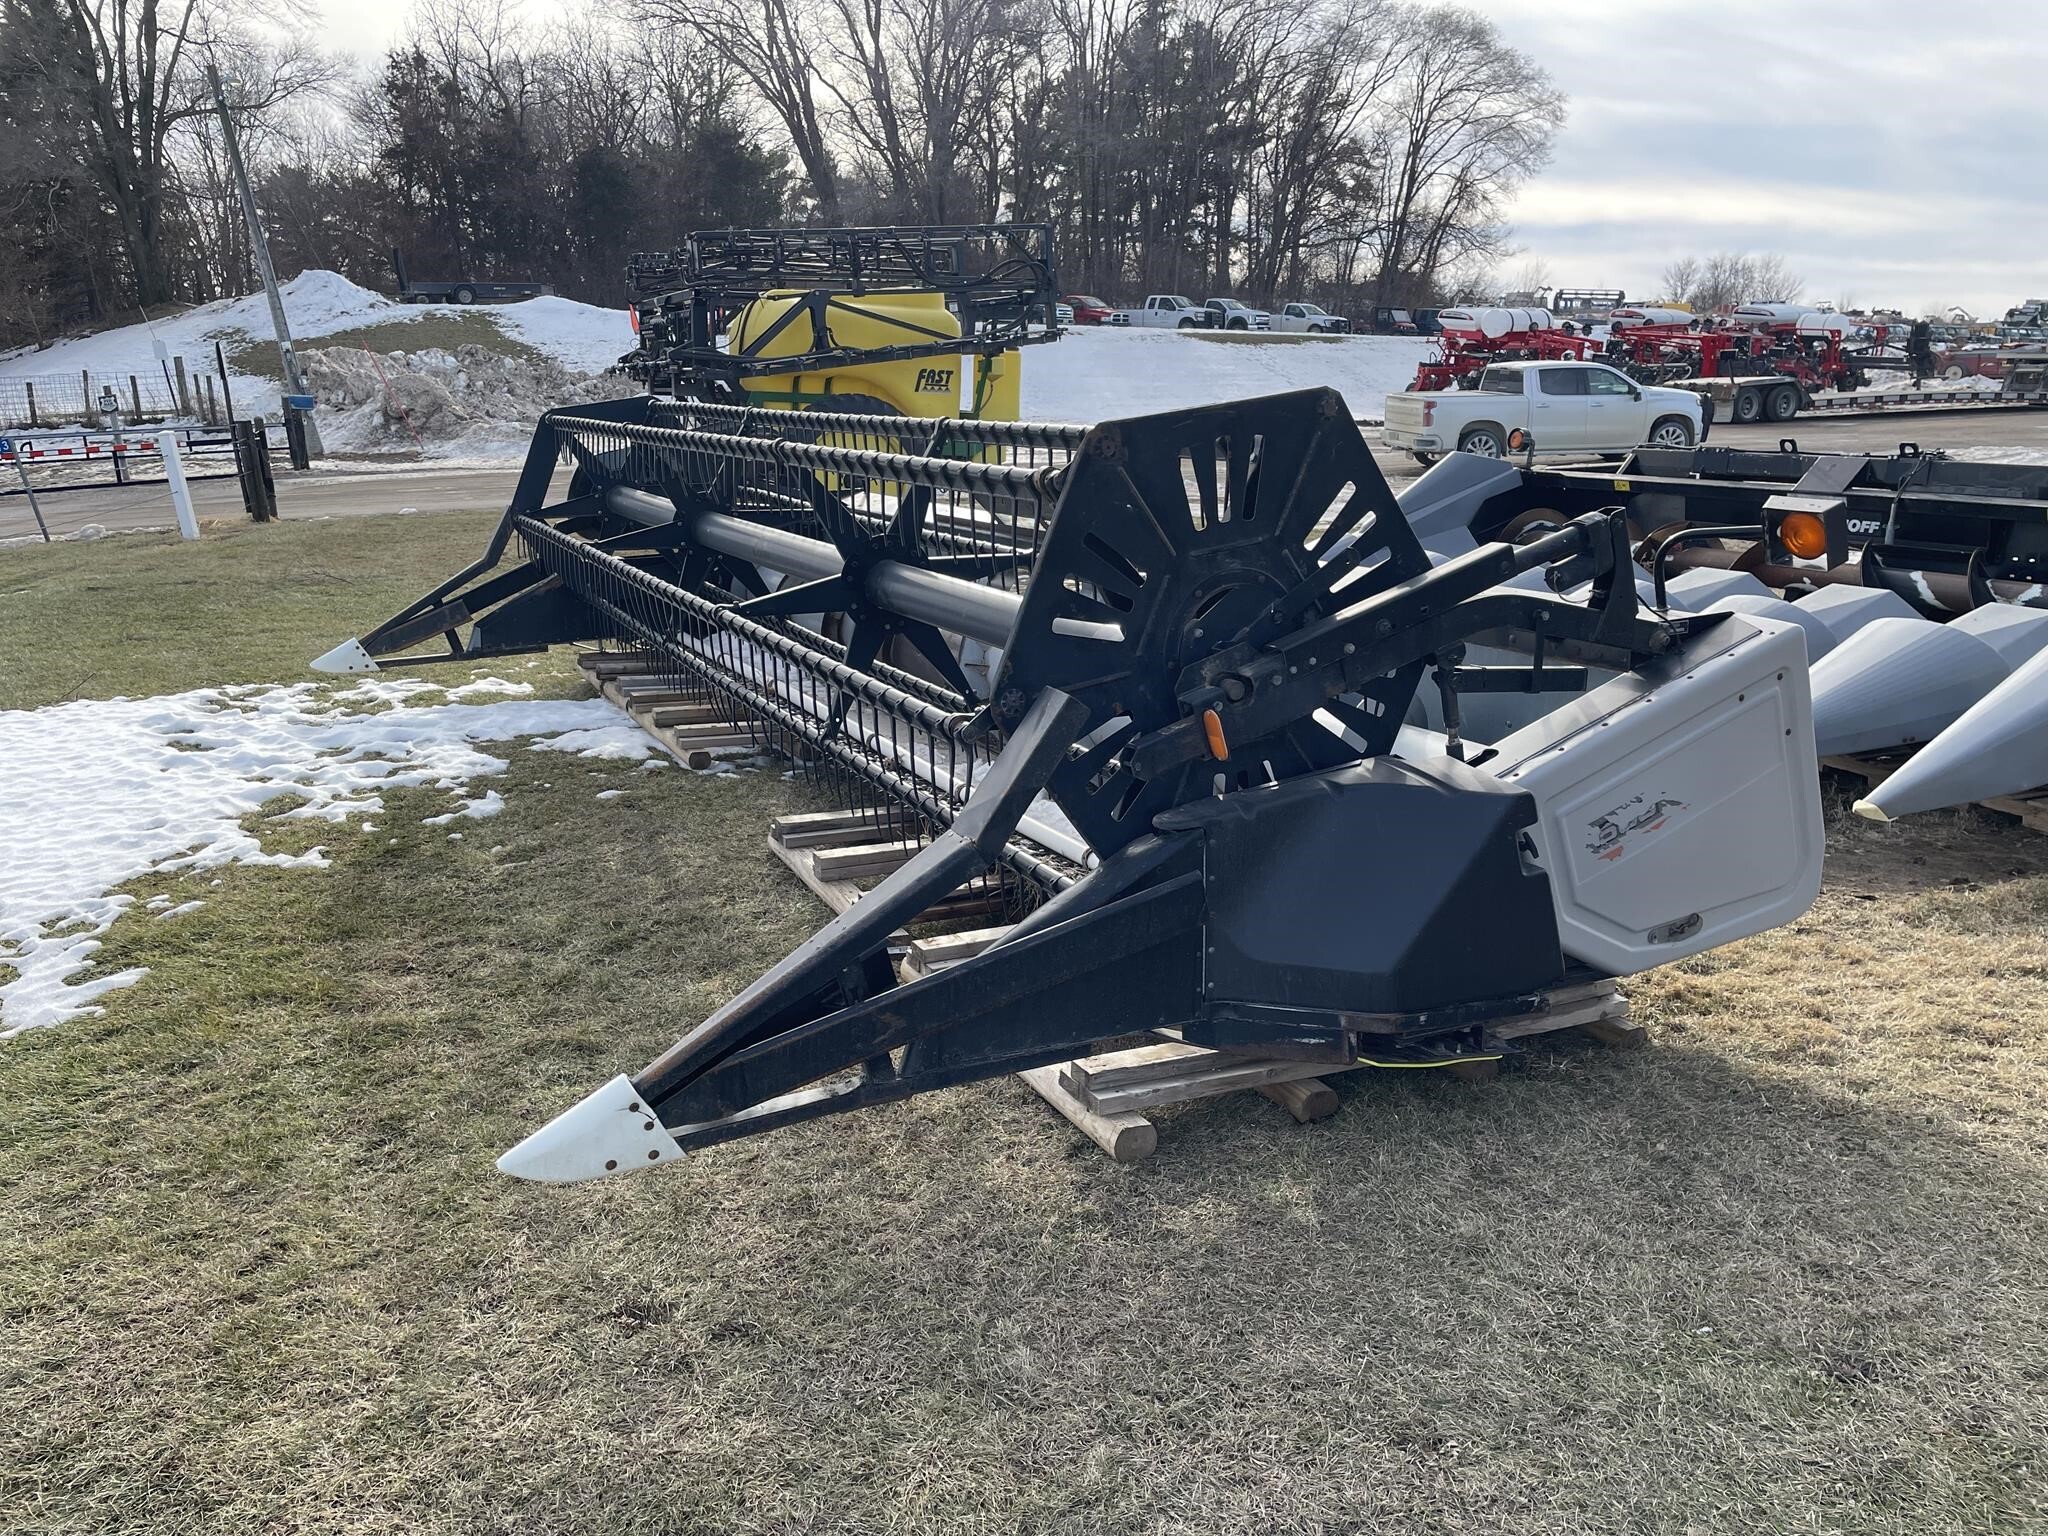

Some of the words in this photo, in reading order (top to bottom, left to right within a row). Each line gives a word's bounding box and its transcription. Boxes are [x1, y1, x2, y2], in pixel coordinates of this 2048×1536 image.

[914, 368, 954, 392] FAST
[0, 440, 9, 451] 3
[1846, 519, 1881, 533] OFF
